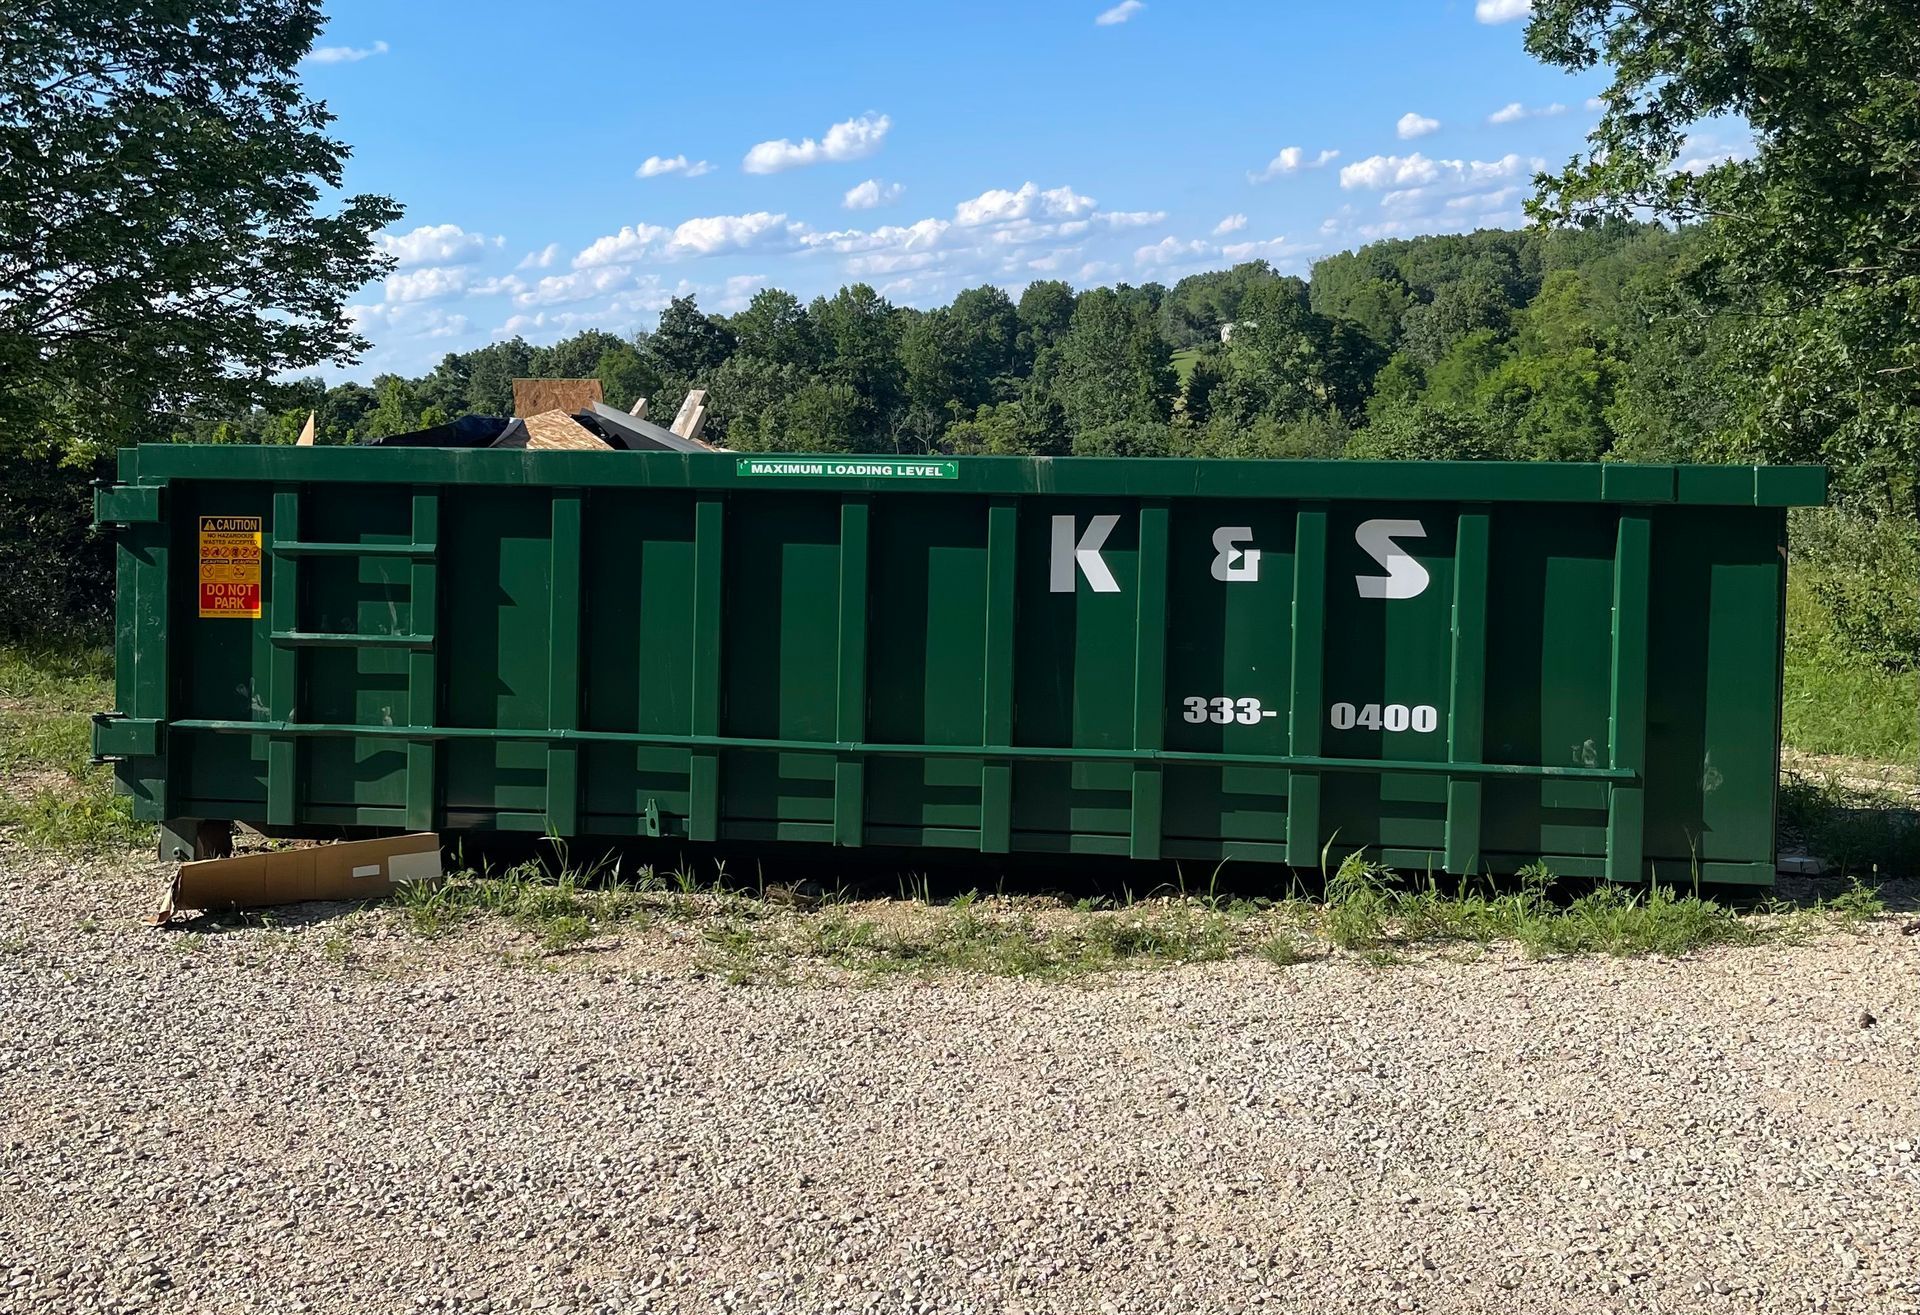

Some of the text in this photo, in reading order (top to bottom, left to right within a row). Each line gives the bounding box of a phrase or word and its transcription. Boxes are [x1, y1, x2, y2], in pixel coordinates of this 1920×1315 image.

[751, 464, 943, 477] MAXIMUM LOADING LEVEL
[216, 519, 258, 531] CAUTION
[1050, 514, 1430, 599] K & S
[206, 584, 254, 596] DO NOT
[214, 597, 246, 609] PARK
[1183, 696, 1438, 733] 333- 0400
